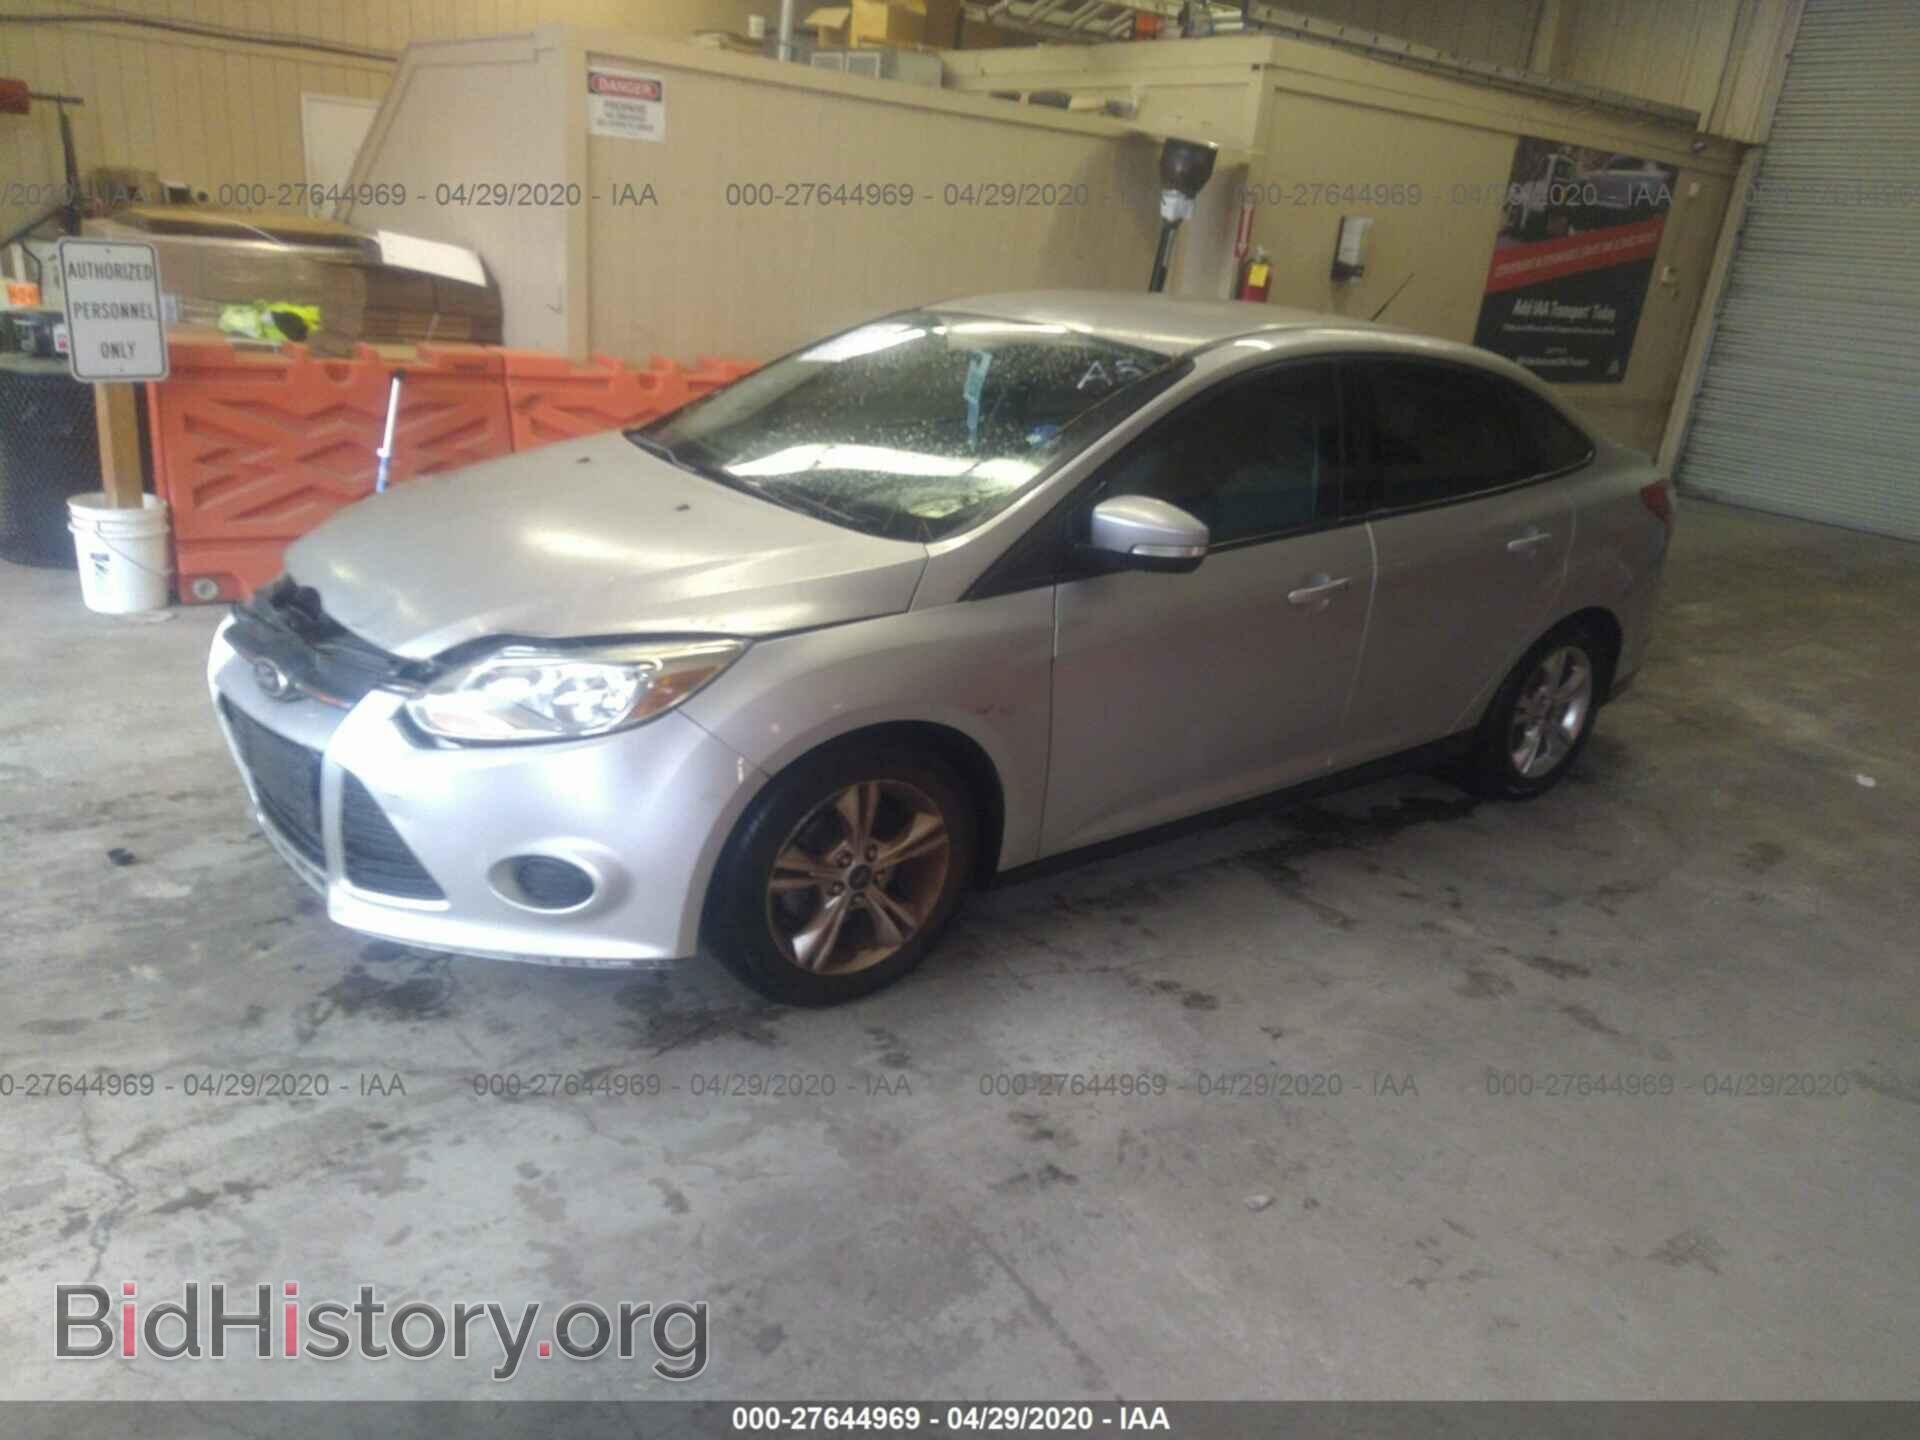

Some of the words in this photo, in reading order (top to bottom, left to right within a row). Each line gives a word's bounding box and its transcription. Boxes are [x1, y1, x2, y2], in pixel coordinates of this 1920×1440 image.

[67, 261, 154, 280] AUTHORIZED
[72, 302, 157, 320] PERSONNEL
[101, 341, 136, 359] ONLY
